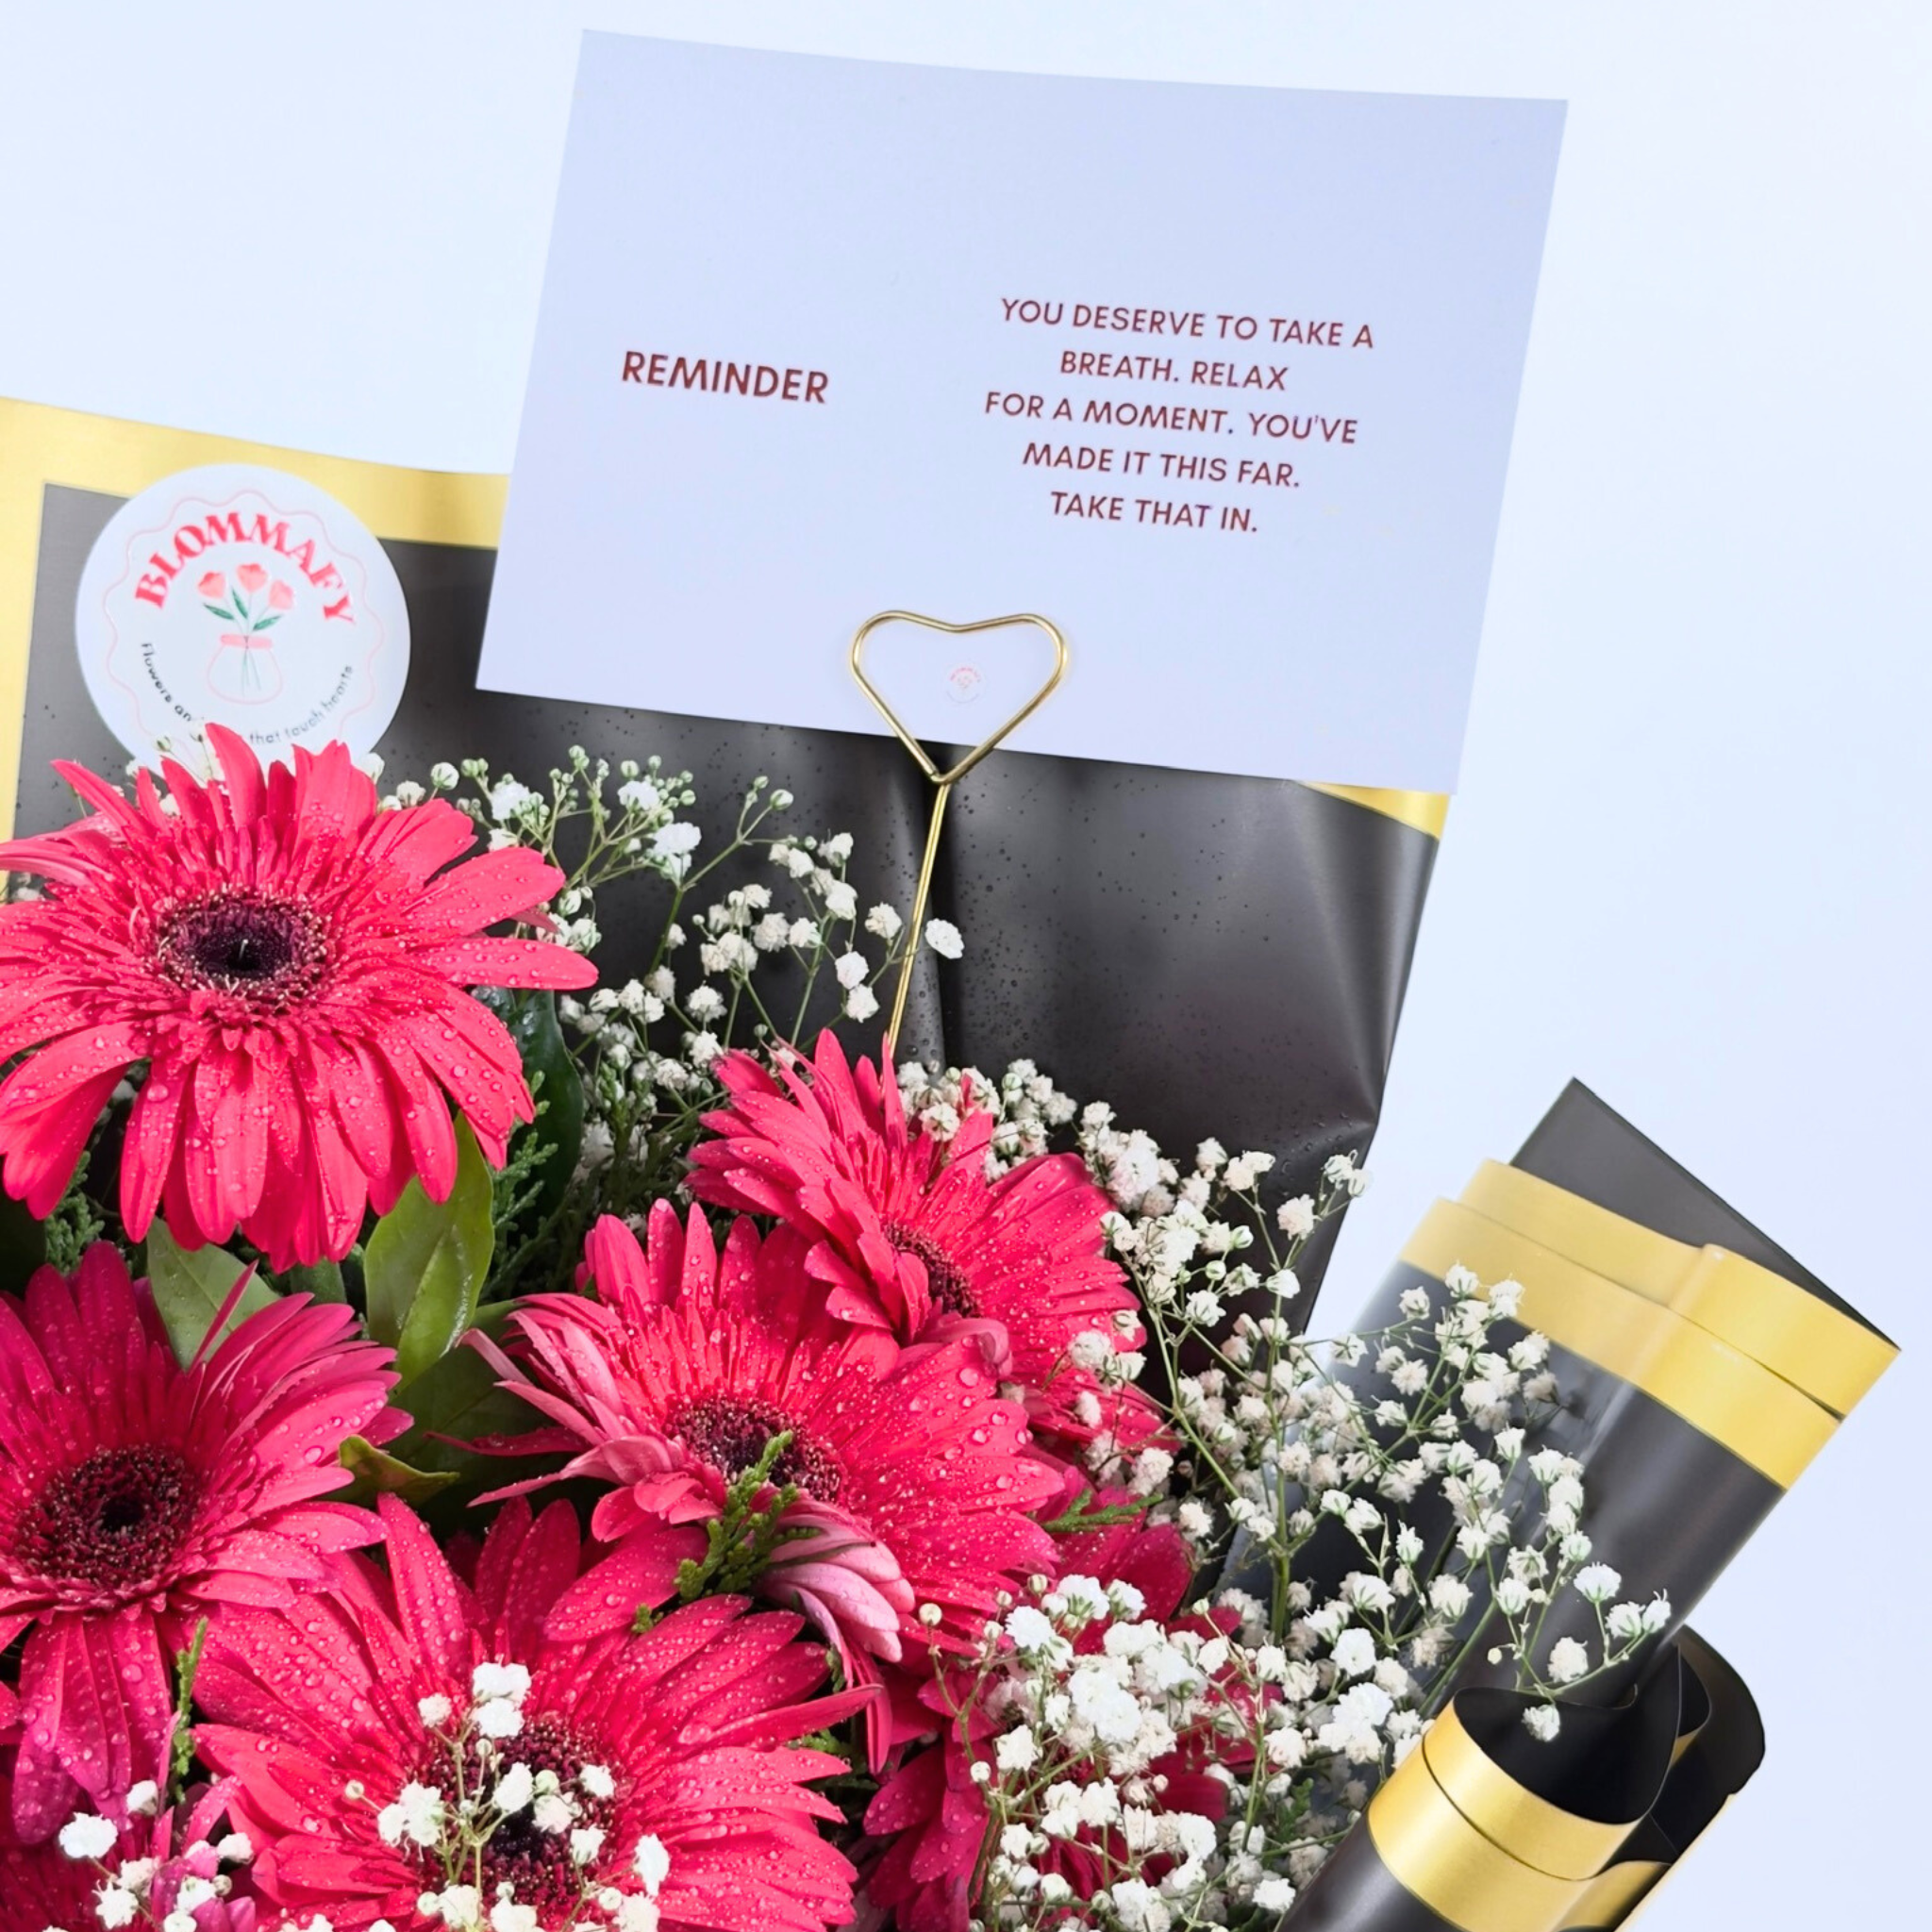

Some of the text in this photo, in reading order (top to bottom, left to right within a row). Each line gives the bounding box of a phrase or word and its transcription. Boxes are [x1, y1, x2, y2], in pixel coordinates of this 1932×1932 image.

[1001, 297, 1374, 349] YOU DESERVE TO TAKE A
[622, 350, 829, 405] REMINDER
[1059, 350, 1289, 391] BREATH. RELAX
[985, 391, 1358, 444] FOR A MOMENT. YOU'VE
[1022, 441, 1300, 488] MADE IT THIS FAR.
[1050, 491, 1257, 533] TAKE THAT IN.
[135, 511, 357, 625] BLOMMAFY
